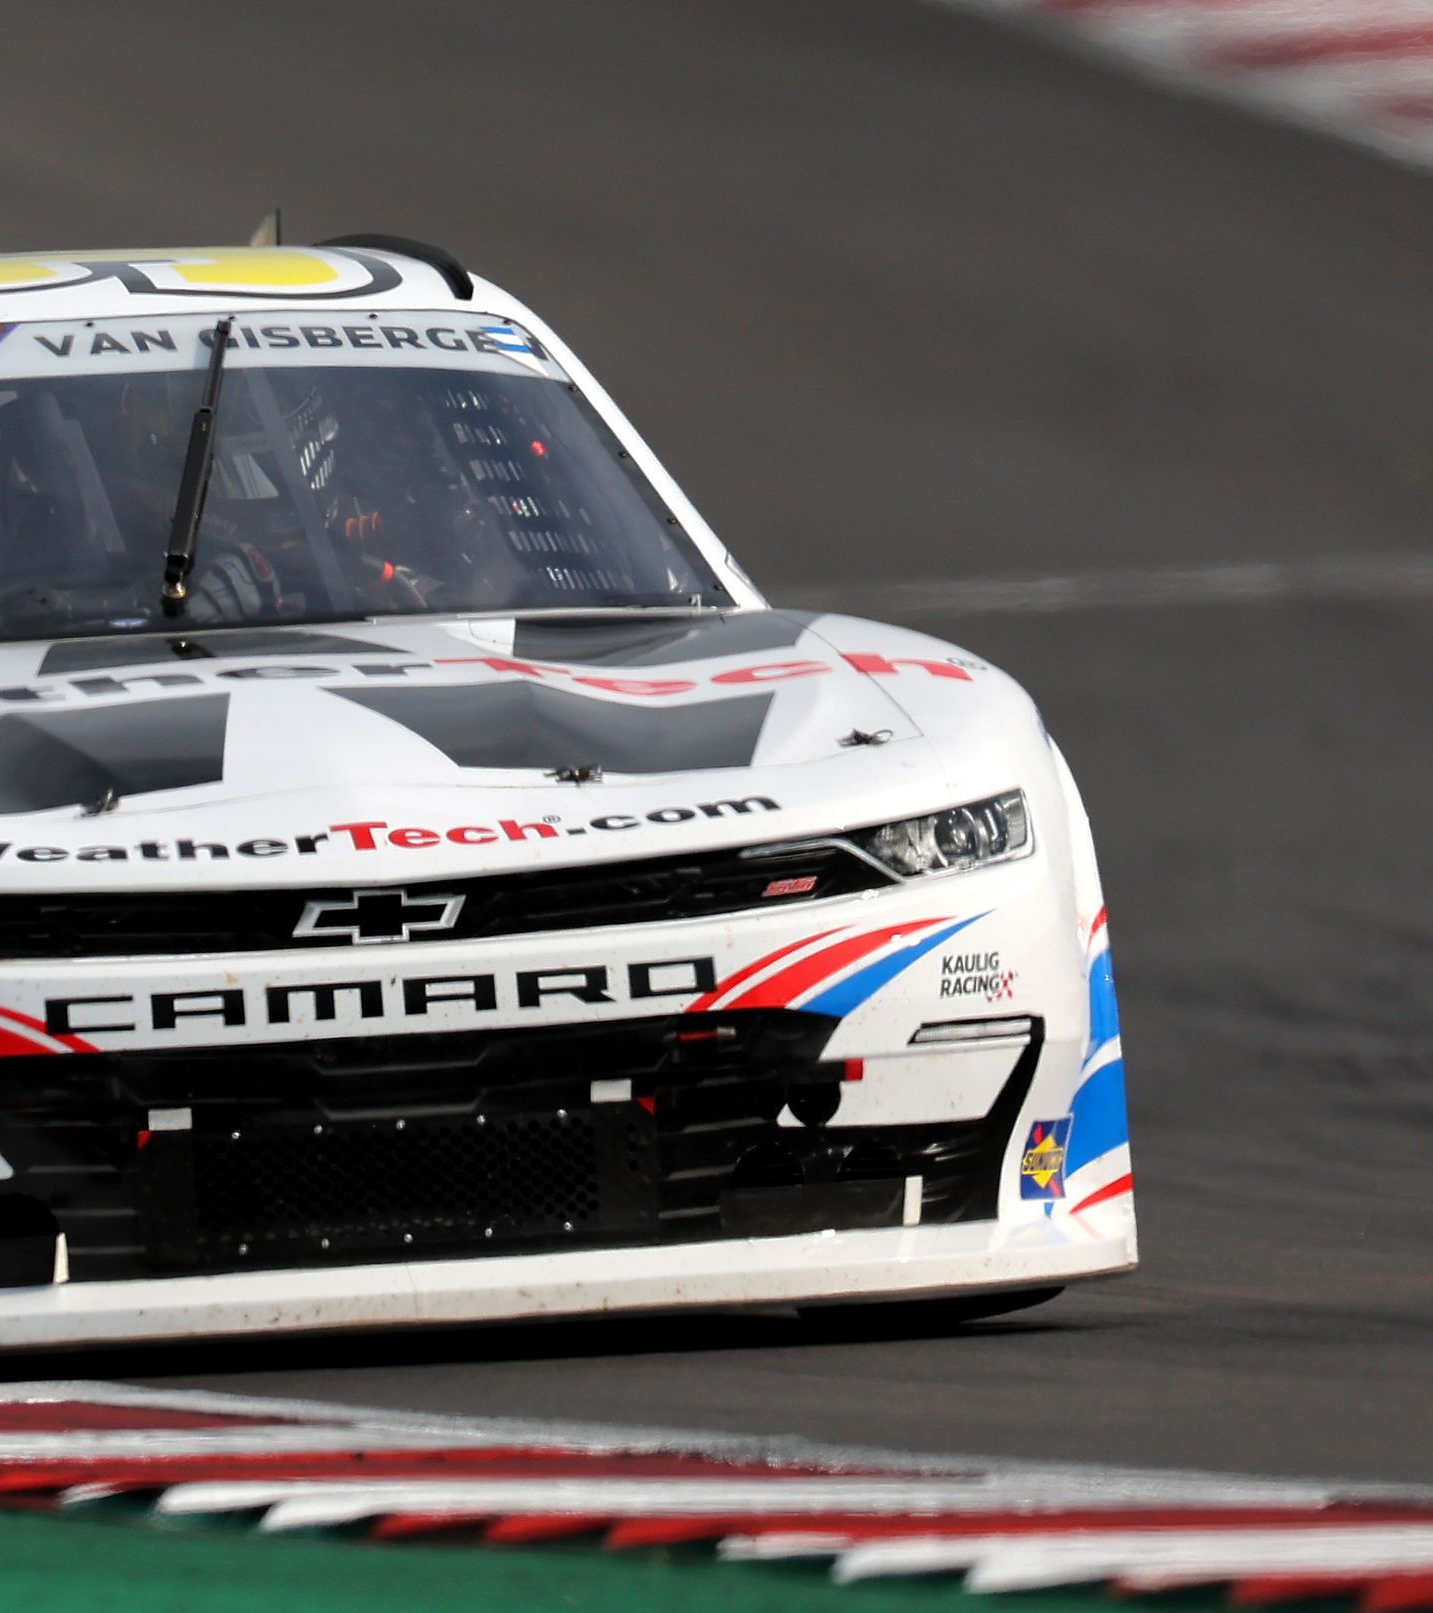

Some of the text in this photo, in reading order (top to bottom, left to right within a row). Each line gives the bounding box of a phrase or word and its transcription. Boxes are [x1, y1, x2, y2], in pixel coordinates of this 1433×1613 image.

[34, 330, 178, 357] VAN
[942, 952, 999, 974] KAULIG
[45, 957, 718, 1034] CAMARO
[940, 975, 1000, 998] RACING
